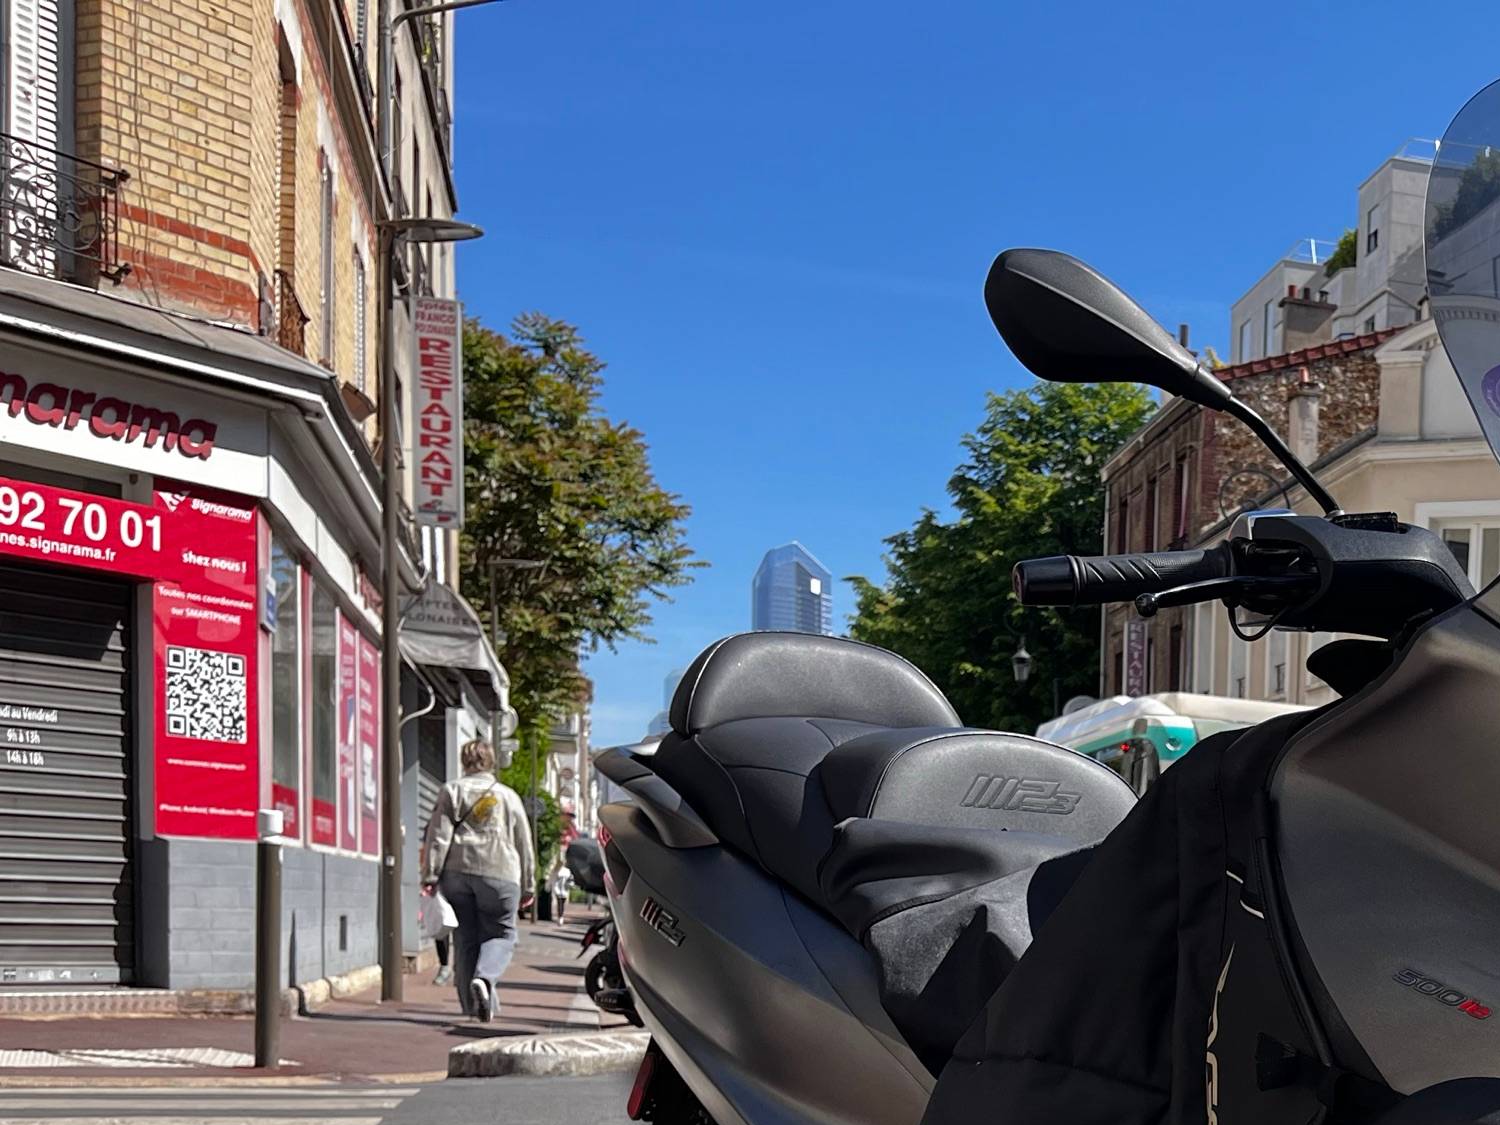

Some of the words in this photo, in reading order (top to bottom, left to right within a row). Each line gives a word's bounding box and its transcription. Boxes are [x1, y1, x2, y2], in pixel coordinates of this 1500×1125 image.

[419, 337, 453, 497] RESTAURANT
[0, 486, 46, 531] 92
[58, 497, 108, 542] 70
[119, 510, 162, 552] 01
[191, 499, 253, 520] signarama
[0, 532, 117, 561] nes.signarama.fr
[185, 608, 242, 626] SMARTPHONE
[11, 708, 21, 719] au
[22, 707, 58, 722] Vendredi
